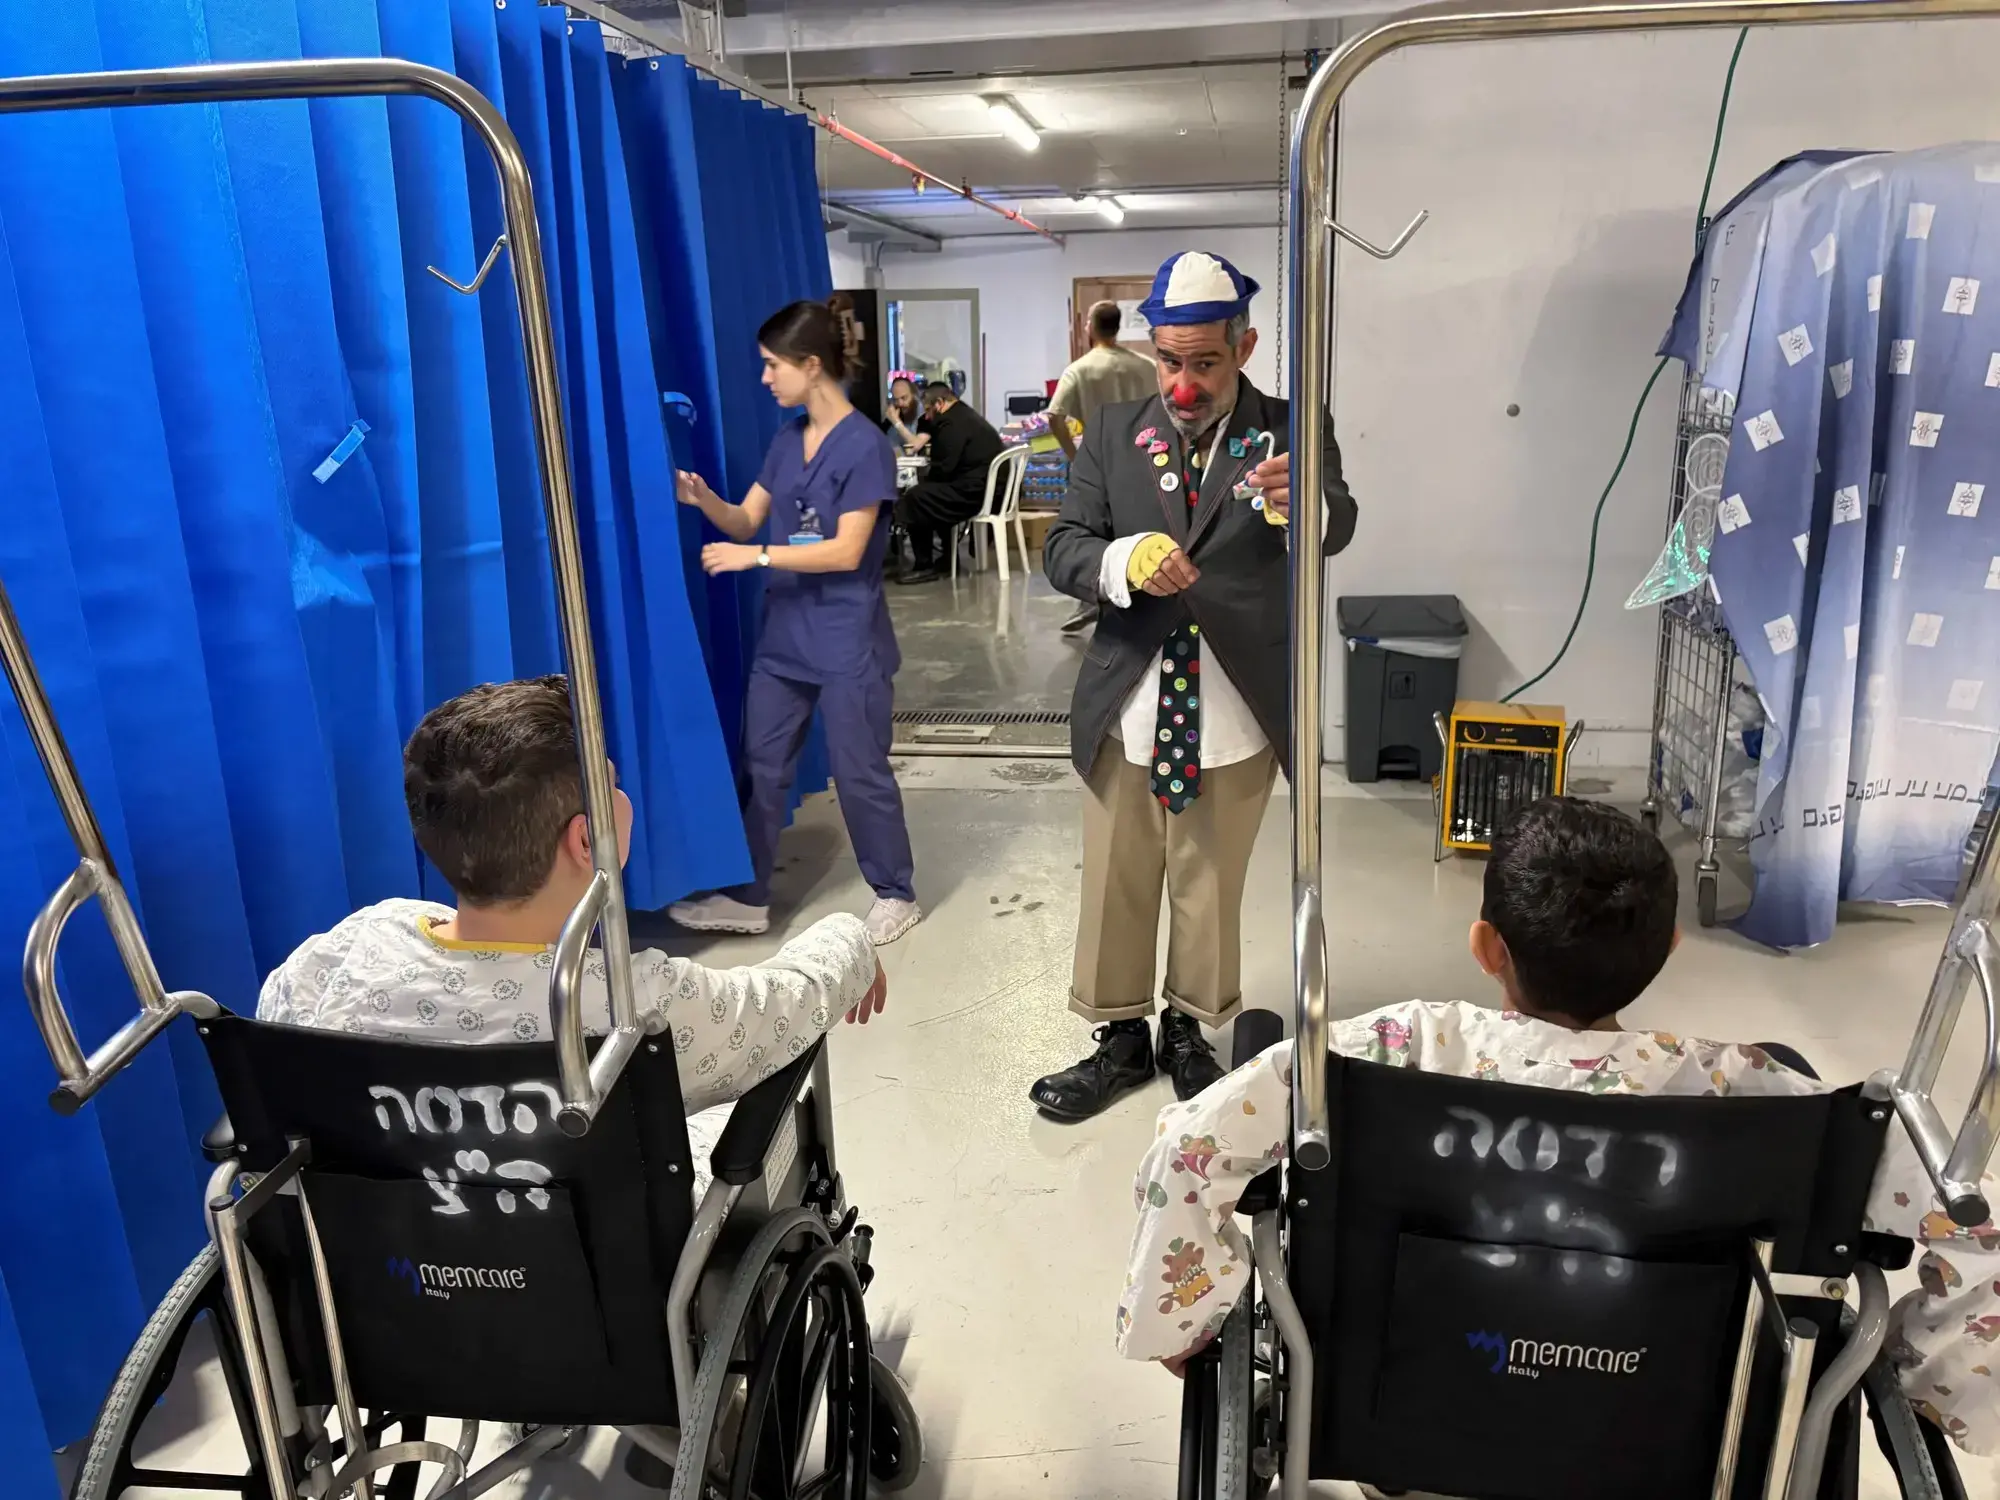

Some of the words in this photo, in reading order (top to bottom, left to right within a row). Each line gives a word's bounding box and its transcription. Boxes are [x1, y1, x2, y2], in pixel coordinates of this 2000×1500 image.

[368, 1082, 563, 1134] הדסה
[425, 1287, 450, 1300] Italy
[1508, 1365, 1539, 1379] Italy
